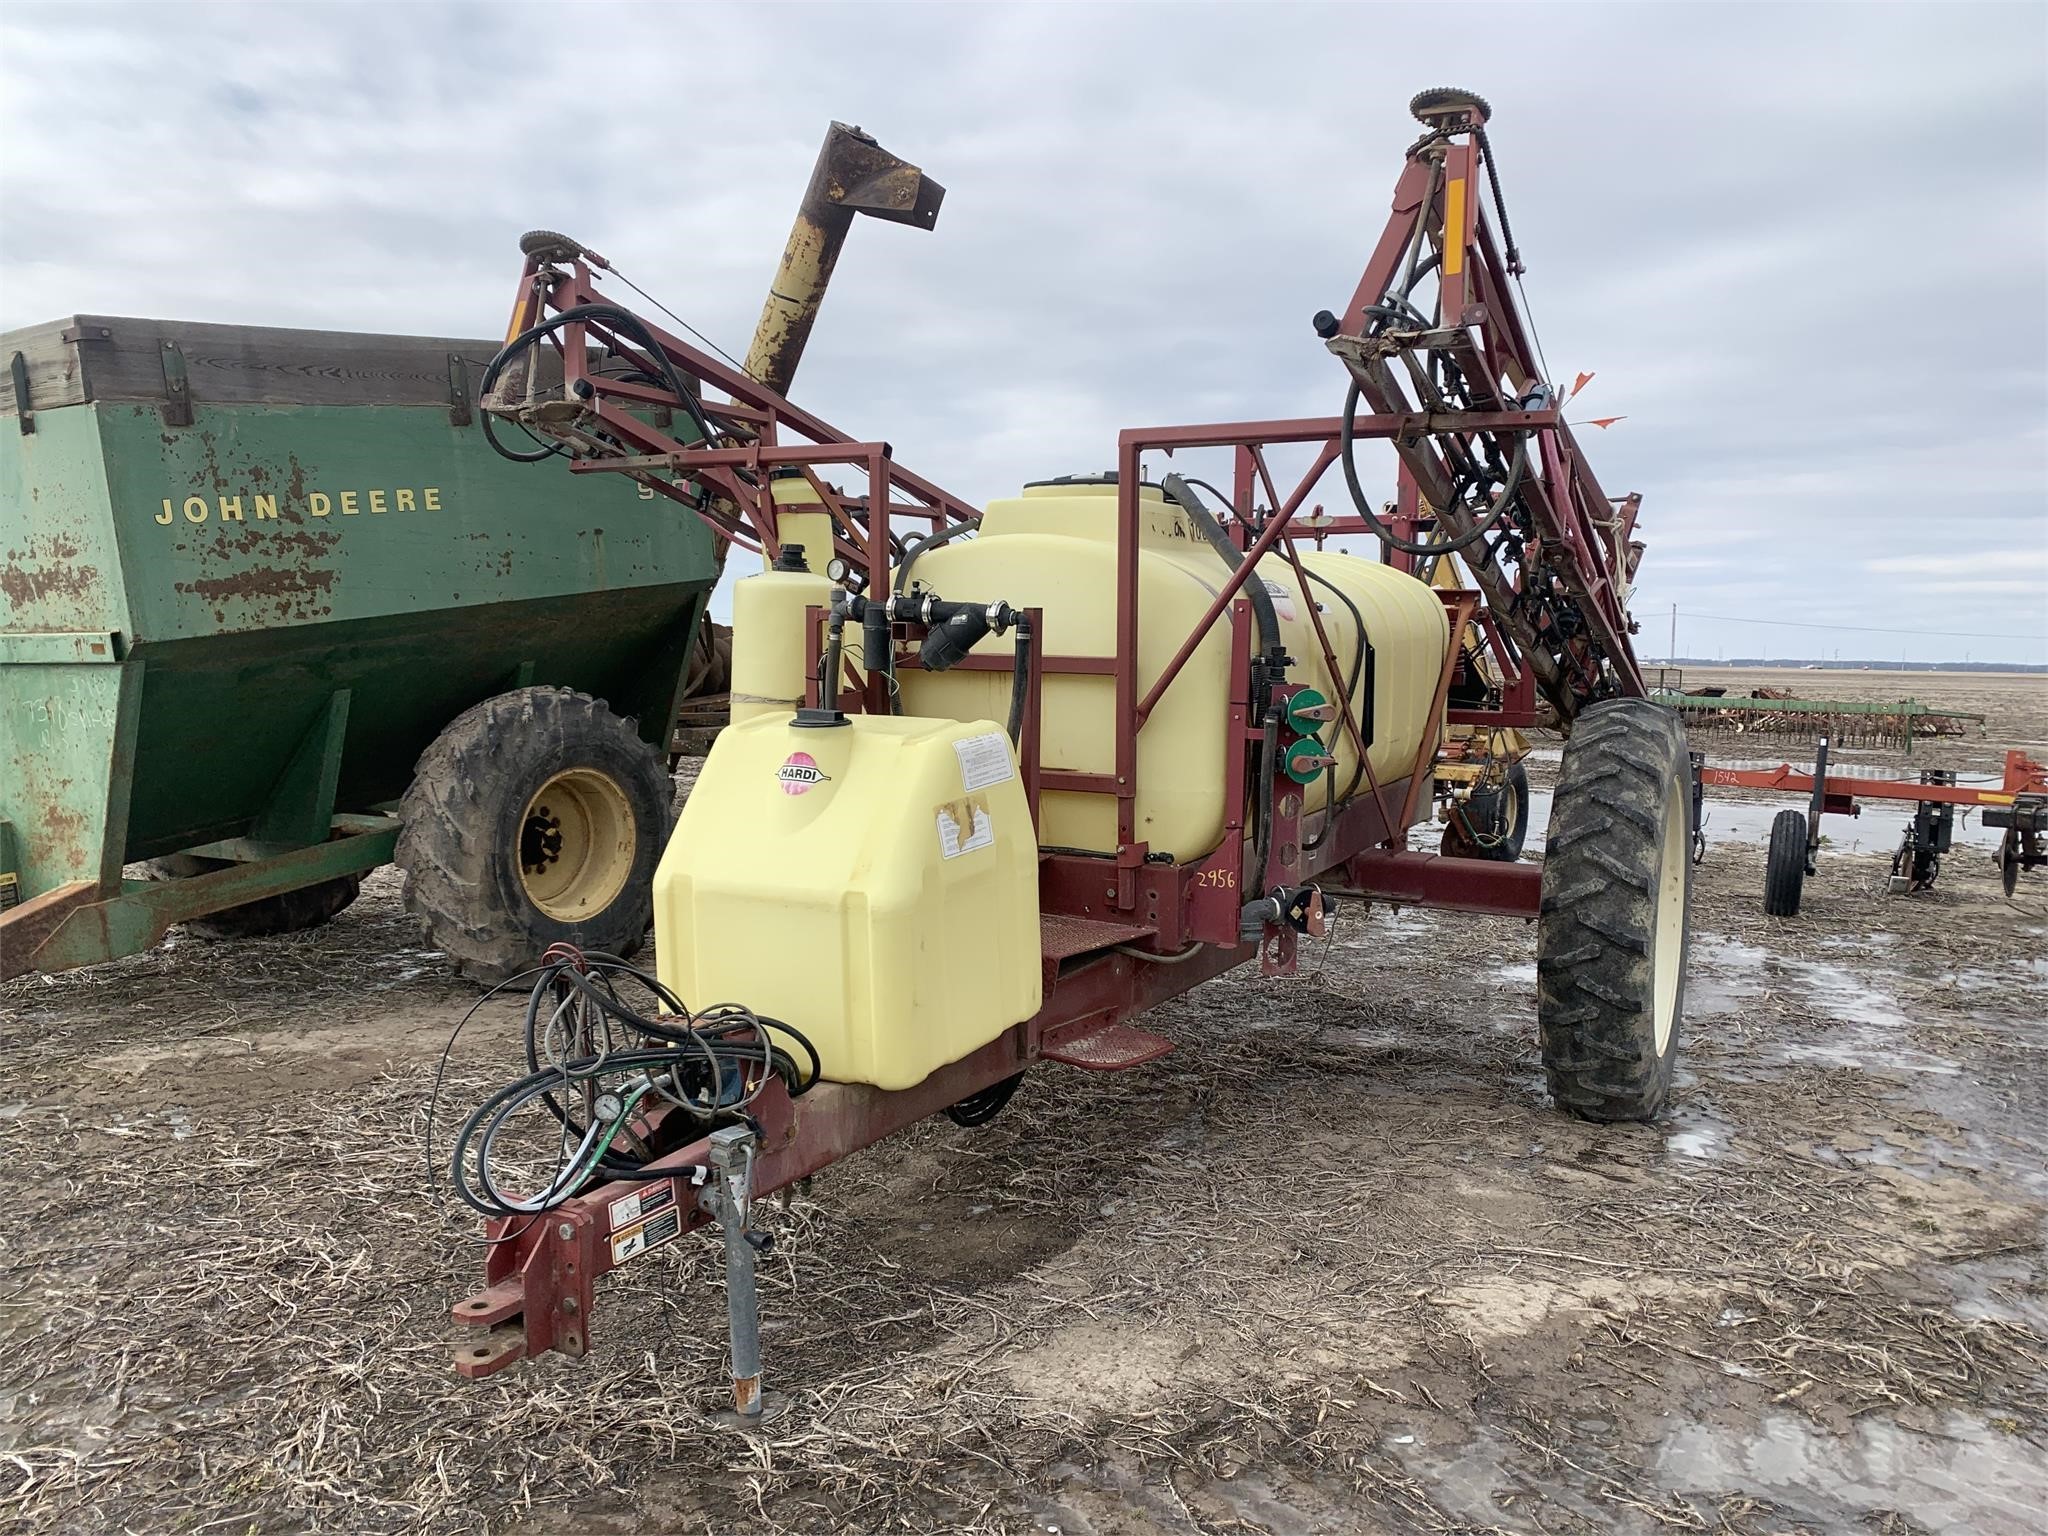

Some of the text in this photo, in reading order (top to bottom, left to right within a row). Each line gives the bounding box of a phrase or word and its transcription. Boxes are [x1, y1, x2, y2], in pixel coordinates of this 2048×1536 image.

[154, 488, 442, 525] JOHN DEERE
[781, 768, 816, 781] HARDI
[1713, 770, 1740, 784] 1542
[1196, 868, 1236, 888] 2956
